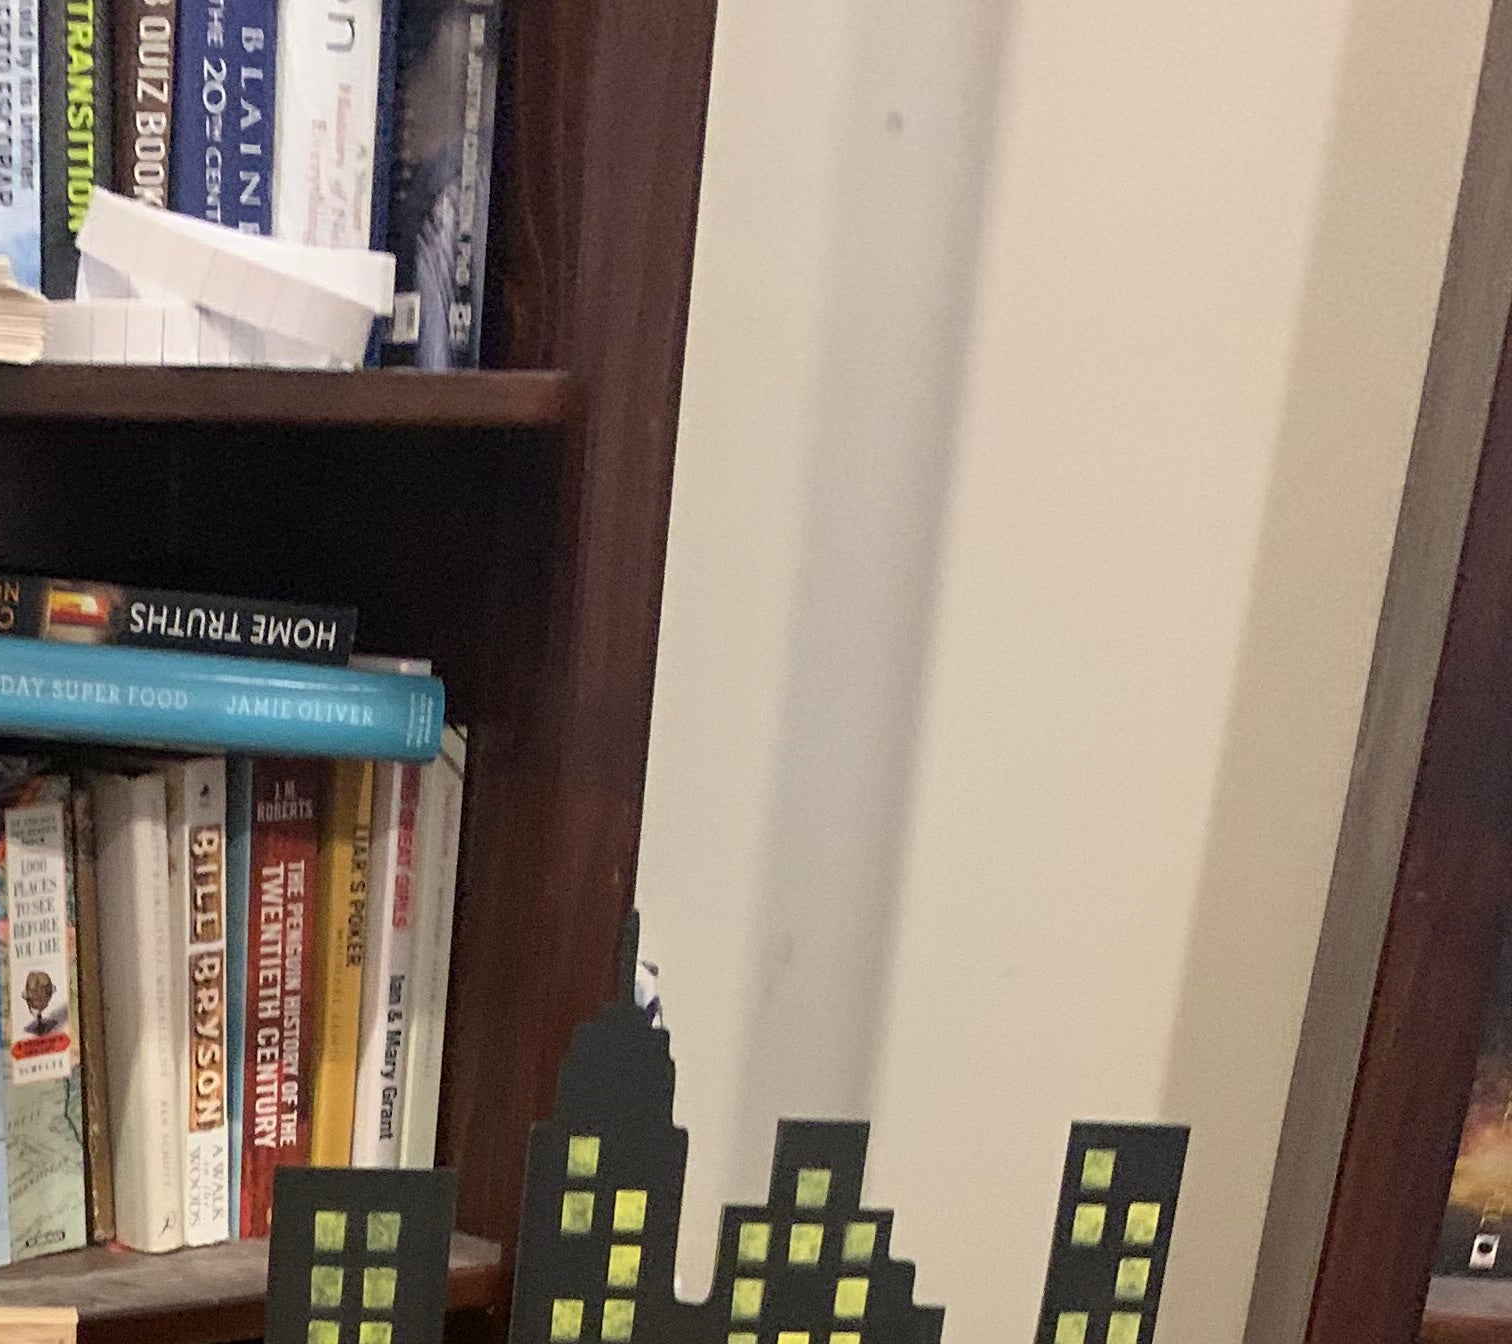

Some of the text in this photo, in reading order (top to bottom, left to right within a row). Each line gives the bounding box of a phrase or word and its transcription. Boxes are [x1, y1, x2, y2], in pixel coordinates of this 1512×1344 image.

[135, 15, 172, 104] QUIZ
[129, 602, 337, 651] HOME TRUTHS
[51, 679, 122, 706] SUPER
[128, 684, 188, 712] FOOD
[224, 694, 293, 719] JAMIE
[297, 701, 375, 728] OLIVER
[256, 800, 315, 822] ROBERTS
[12, 878, 58, 898] PLACES
[16, 896, 57, 919] TO SEE
[12, 916, 60, 940] BEFORE
[14, 936, 61, 959] YOU DIE
[345, 899, 367, 968] POKER
[192, 829, 223, 1128] BILL BRYSON
[279, 858, 305, 1147] THE PENGUIN HISTORY OF THE
[253, 860, 285, 1150] TWENTIETH CENTURY
[387, 1010, 403, 1024] &
[379, 1029, 402, 1081] Mary
[378, 1086, 398, 1142] Grant
[188, 1145, 202, 1227] WOODS
[211, 1161, 225, 1222] WALK
